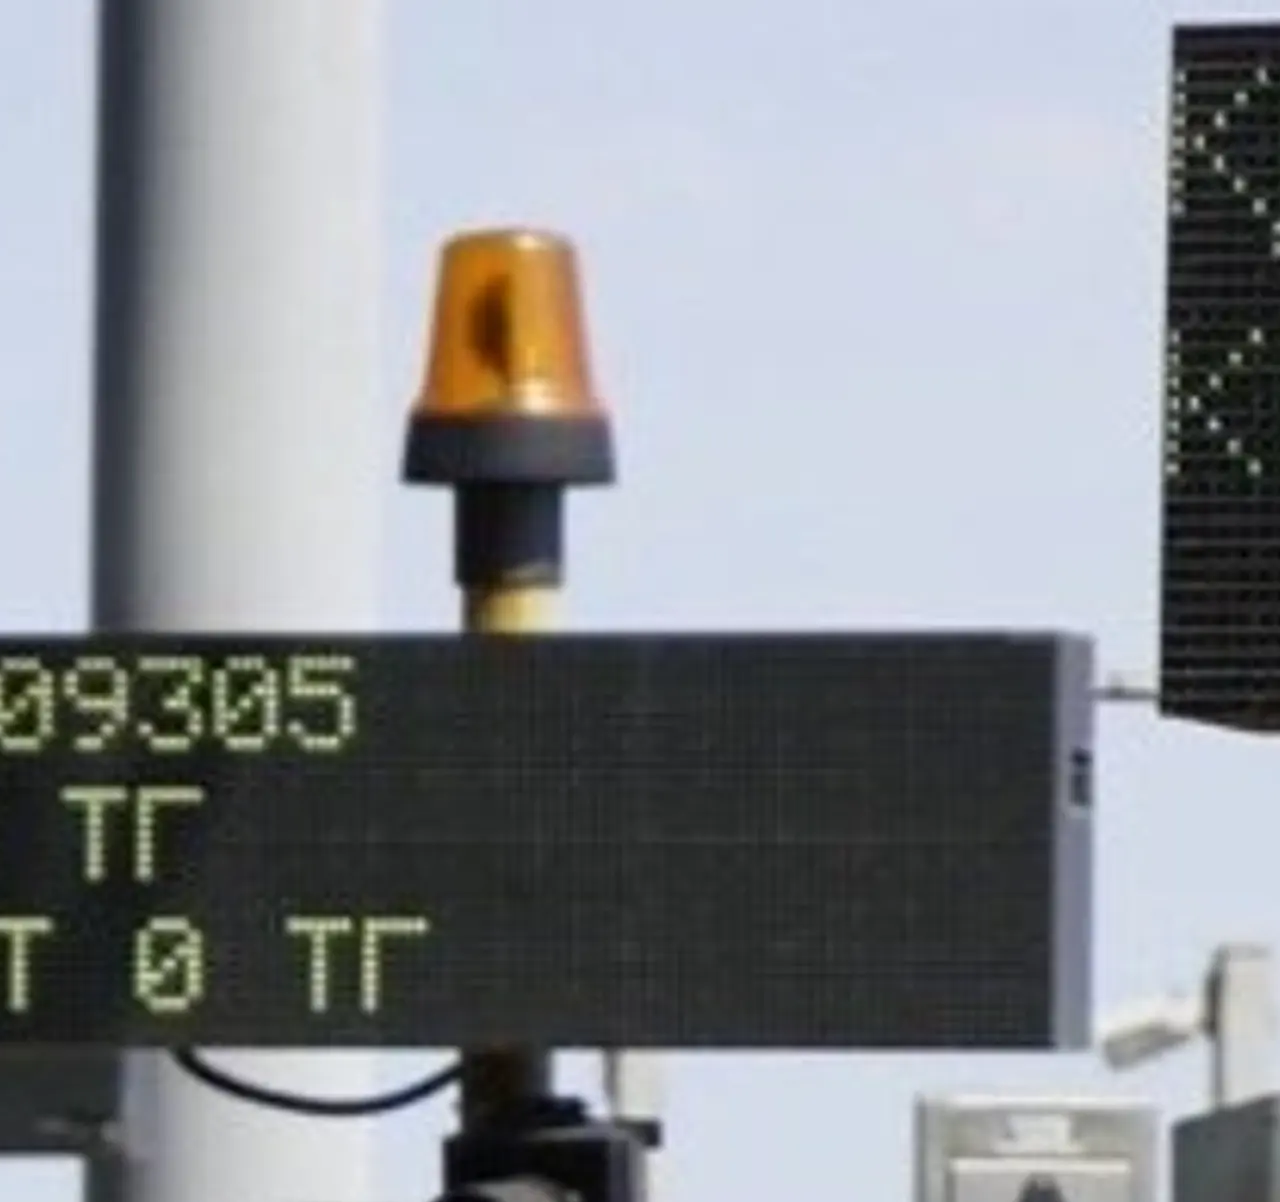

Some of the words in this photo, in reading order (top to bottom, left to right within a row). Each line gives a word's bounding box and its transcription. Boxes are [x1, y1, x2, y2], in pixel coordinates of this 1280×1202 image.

[60, 785, 206, 882] ТГ
[132, 915, 205, 1013] 0
[284, 915, 431, 1014] ТГ
